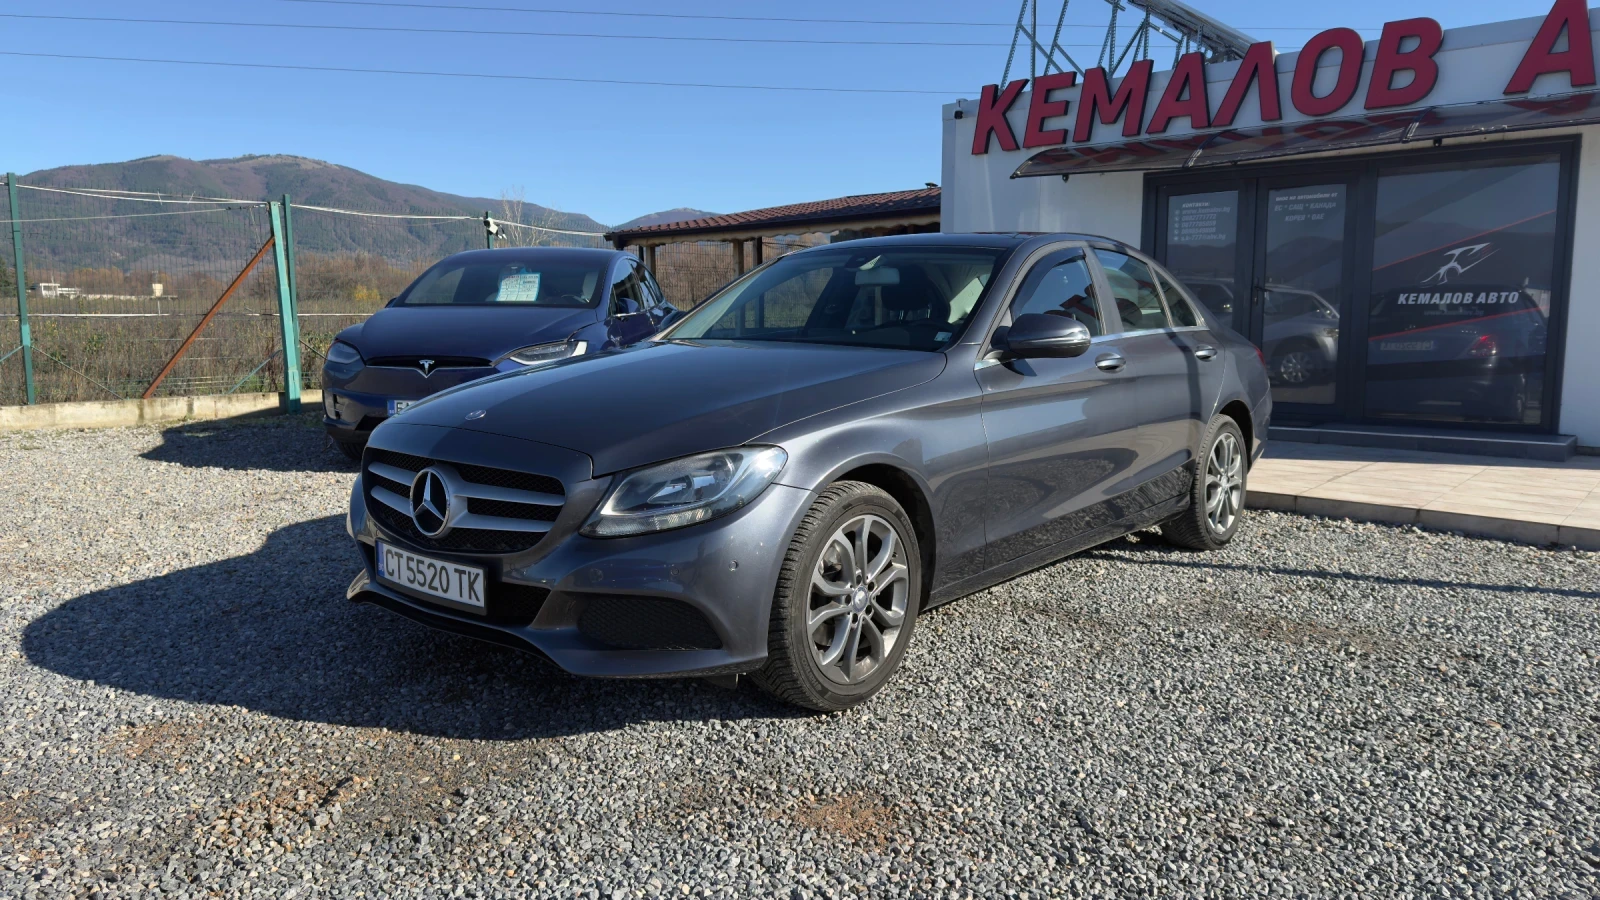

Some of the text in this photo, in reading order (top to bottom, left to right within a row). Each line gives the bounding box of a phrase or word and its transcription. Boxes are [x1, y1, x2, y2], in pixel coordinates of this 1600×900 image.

[971, 16, 1445, 155] КЕМАЛОВ
[1397, 291, 1520, 305] КЕМАЛОВ АВТО
[385, 548, 481, 602] CT 5520 TK
